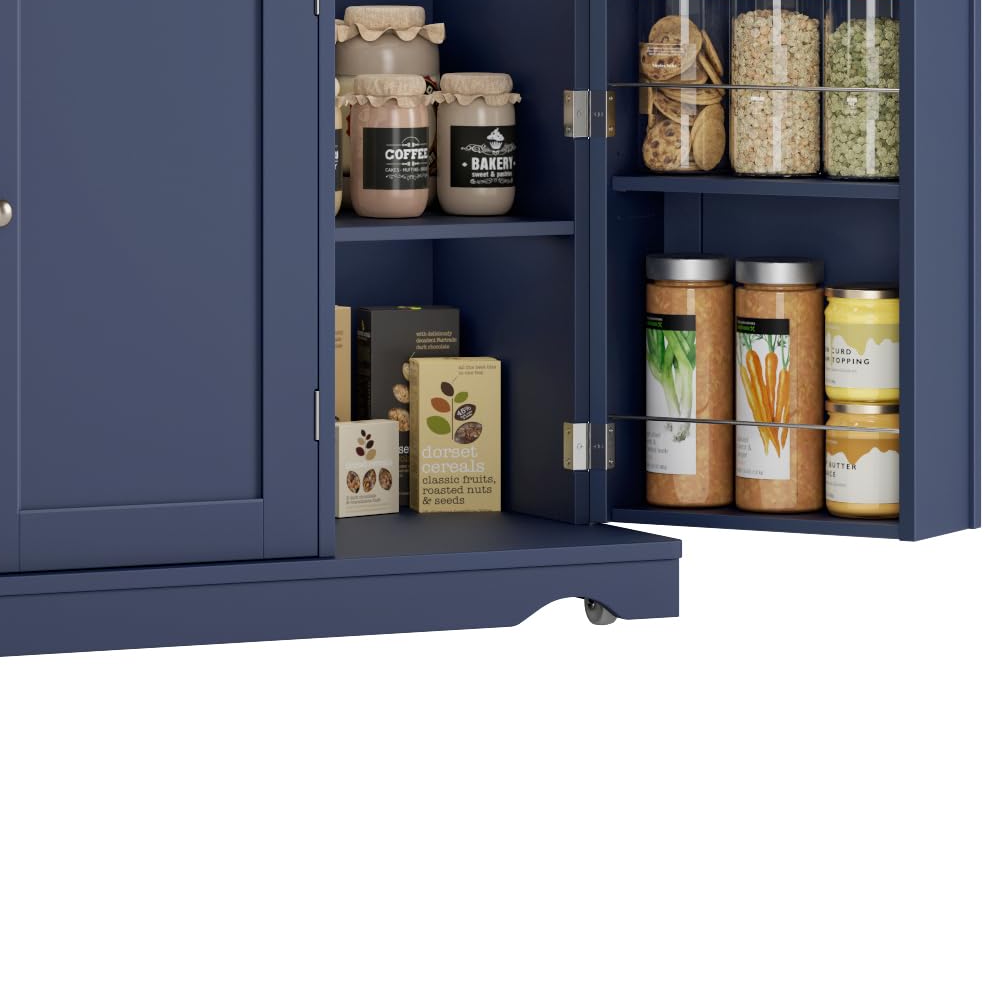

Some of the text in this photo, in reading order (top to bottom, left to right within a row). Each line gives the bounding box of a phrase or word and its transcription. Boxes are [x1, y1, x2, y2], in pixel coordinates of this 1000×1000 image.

[384, 148, 428, 160] COFFEE
[471, 156, 513, 171] BAKERY
[832, 357, 870, 365] TOPPING
[421, 445, 478, 459] dorset
[421, 459, 486, 473] cereals
[422, 475, 497, 485] classic fruits,
[422, 485, 493, 495] roasted nuts
[422, 496, 466, 505] & seeds
